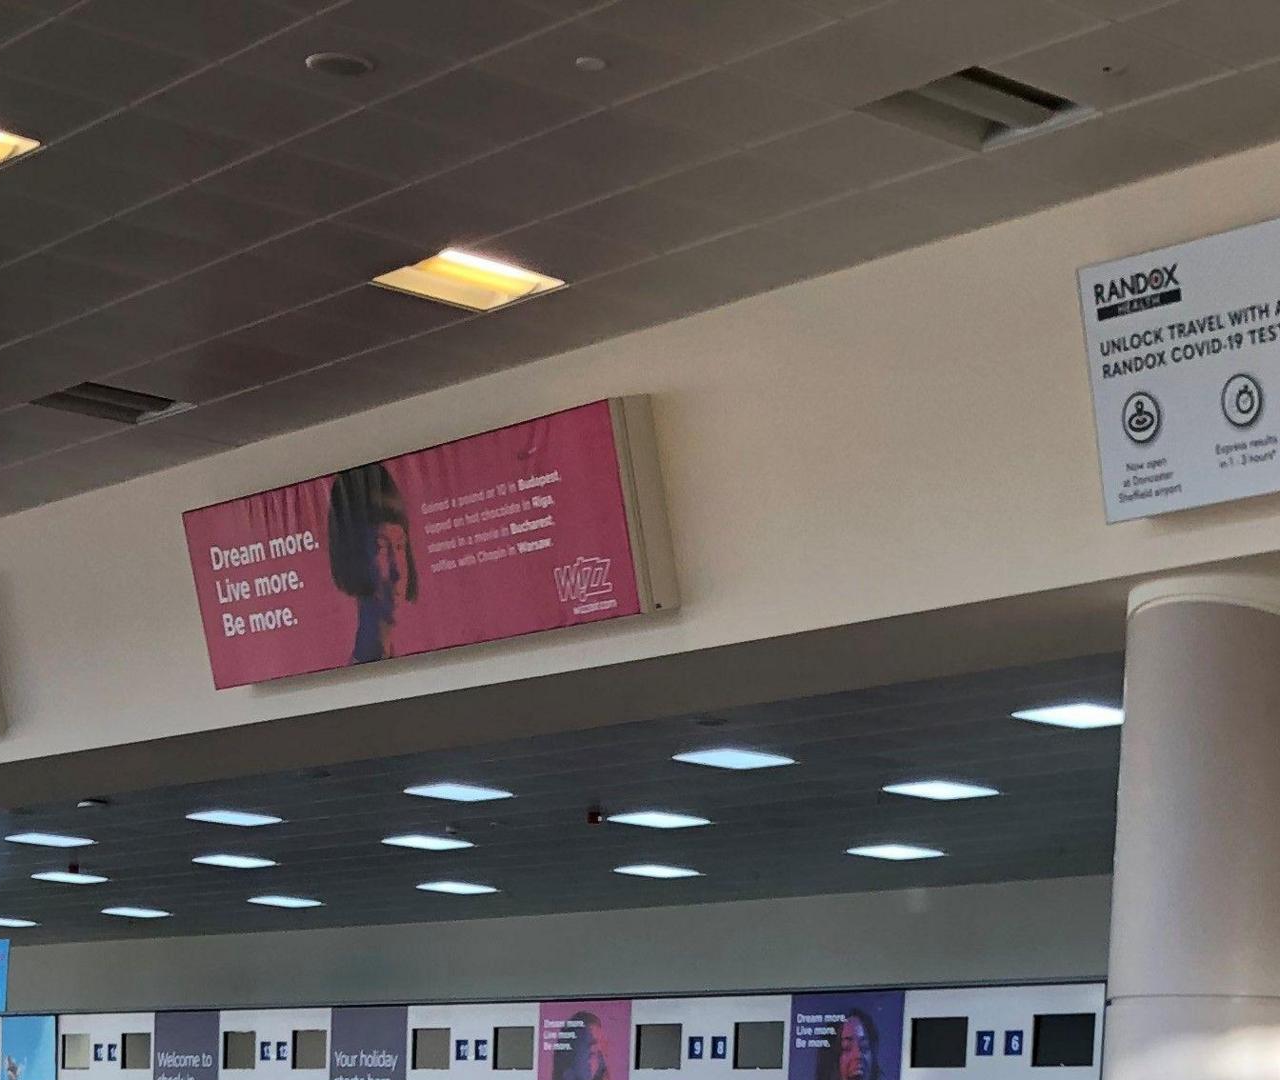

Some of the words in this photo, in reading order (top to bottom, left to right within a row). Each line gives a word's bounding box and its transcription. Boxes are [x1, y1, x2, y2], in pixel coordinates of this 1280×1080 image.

[1094, 263, 1179, 306] RANDOX
[1100, 327, 1164, 357] UNLOCK
[1168, 314, 1225, 340] TRAVEL
[1227, 303, 1269, 327] WITH
[1102, 350, 1167, 379] RANDOX
[1171, 332, 1243, 363] COVID-19
[210, 542, 265, 570] Dream
[269, 531, 319, 559] more.
[216, 579, 250, 604] Live
[254, 570, 304, 597] more.
[222, 613, 245, 637] Be
[249, 607, 298, 633] more.
[797, 1014, 823, 1023] Dream
[824, 1014, 848, 1022] more.
[796, 1025, 813, 1036] Live
[814, 1026, 837, 1035] more.
[693, 1041, 701, 1055] 9
[717, 1041, 724, 1055] 8
[795, 1038, 807, 1048] Be
[808, 1039, 831, 1048] more.
[983, 1035, 991, 1051] 7
[1011, 1035, 1020, 1051] 6
[157, 1050, 200, 1068] Welcome
[201, 1051, 213, 1067] to
[334, 1050, 357, 1067] Your
[359, 1050, 398, 1072] holiday
